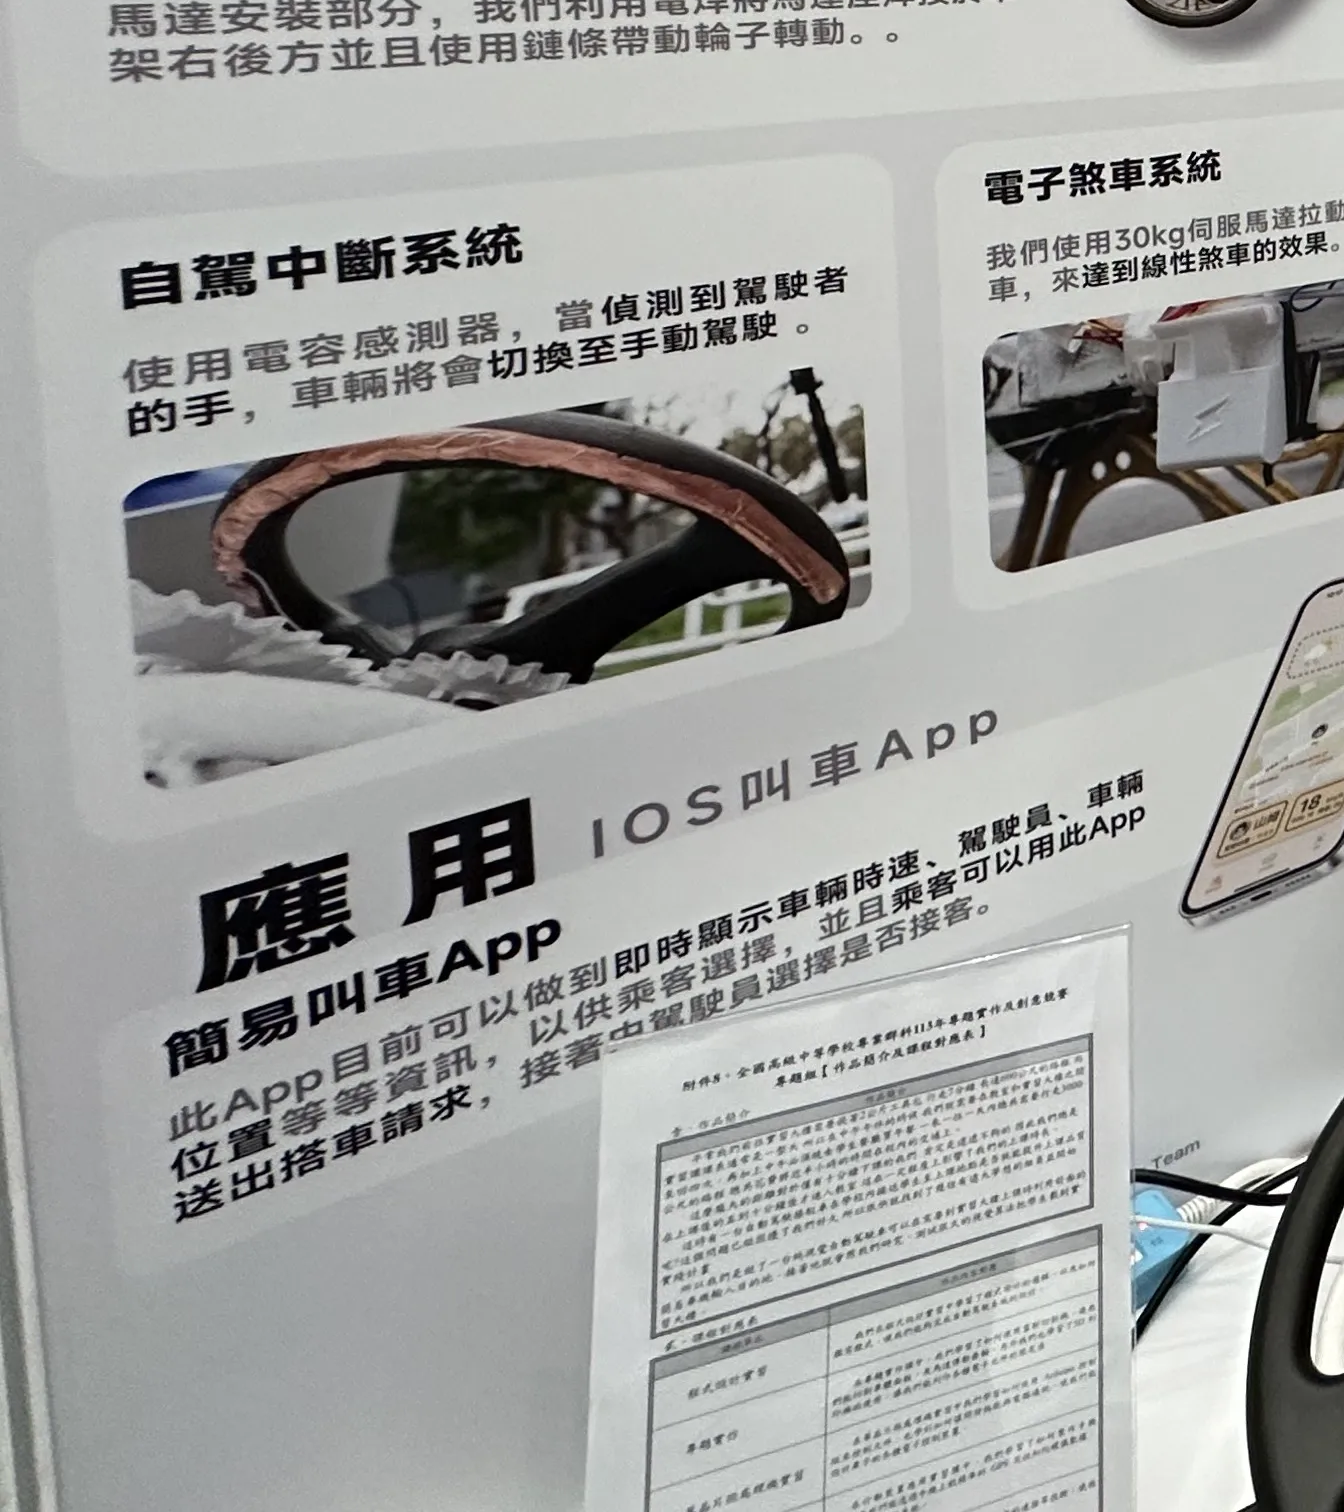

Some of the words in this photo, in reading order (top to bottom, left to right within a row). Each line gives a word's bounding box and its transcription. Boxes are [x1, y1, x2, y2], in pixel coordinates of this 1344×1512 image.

[985, 149, 1221, 206] 電子煞車系統
[121, 223, 522, 309] 自駕中斷系統
[987, 231, 1341, 302] 車，來達到線性煞車的效果。
[122, 265, 849, 394] 使用電容感測器，當偵測到駕駛者
[196, 797, 538, 994] 應用
[165, 916, 562, 1078] 簡易叫車App
[1152, 1140, 1200, 1169] Team
